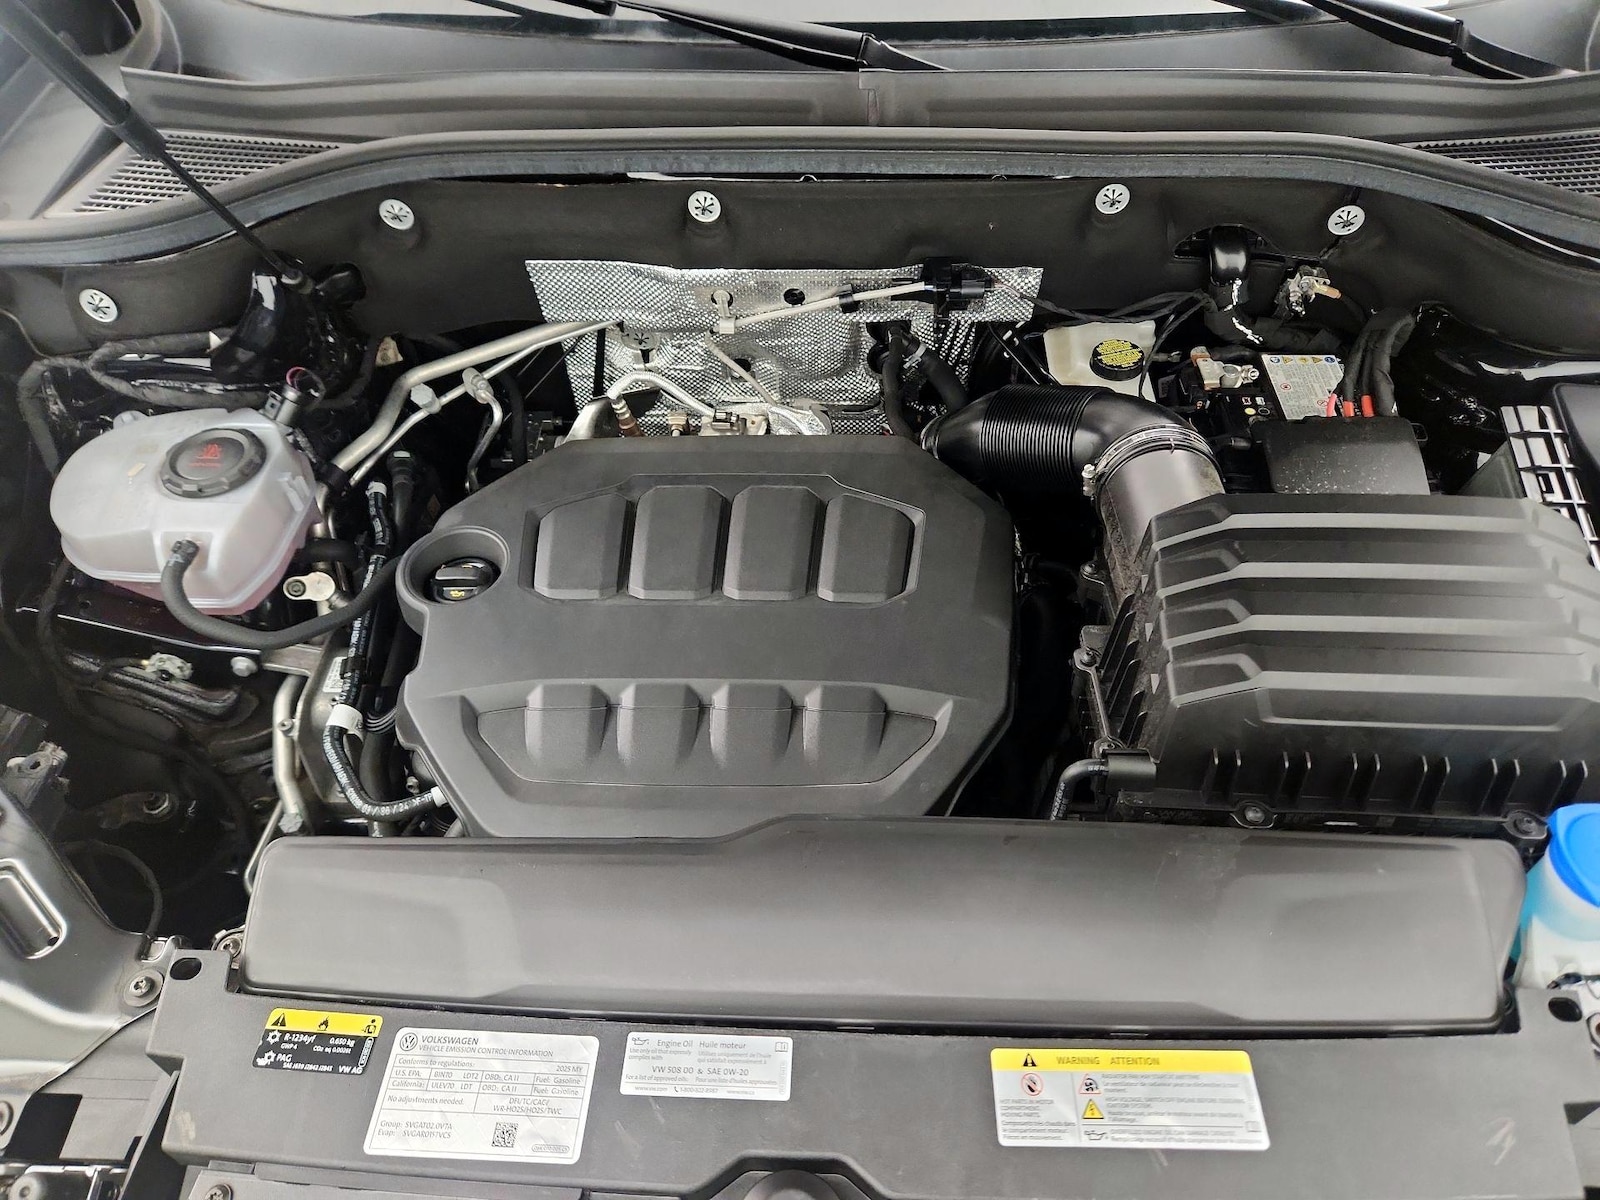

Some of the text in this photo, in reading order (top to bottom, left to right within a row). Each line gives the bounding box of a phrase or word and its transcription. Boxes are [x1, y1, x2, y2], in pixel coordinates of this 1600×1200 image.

[284, 1033, 316, 1044] R-1234yf
[421, 1036, 479, 1045] VOLKSWAGEN
[657, 1039, 693, 1048] Engine Oil
[446, 1046, 476, 1054] EMISSION
[477, 1047, 506, 1055] CONTROL
[508, 1048, 553, 1057] INFORMATION
[276, 1053, 292, 1062] PAG
[1056, 1056, 1160, 1066] WARNING ATTENTION
[399, 1057, 428, 1065] Conforms
[438, 1060, 475, 1068] regulations:
[339, 1065, 363, 1074] VW AG
[707, 1068, 721, 1076] SAE
[723, 1068, 749, 1076] 0W-20
[463, 1072, 479, 1080] LDT2
[554, 1077, 581, 1085] Gasoline
